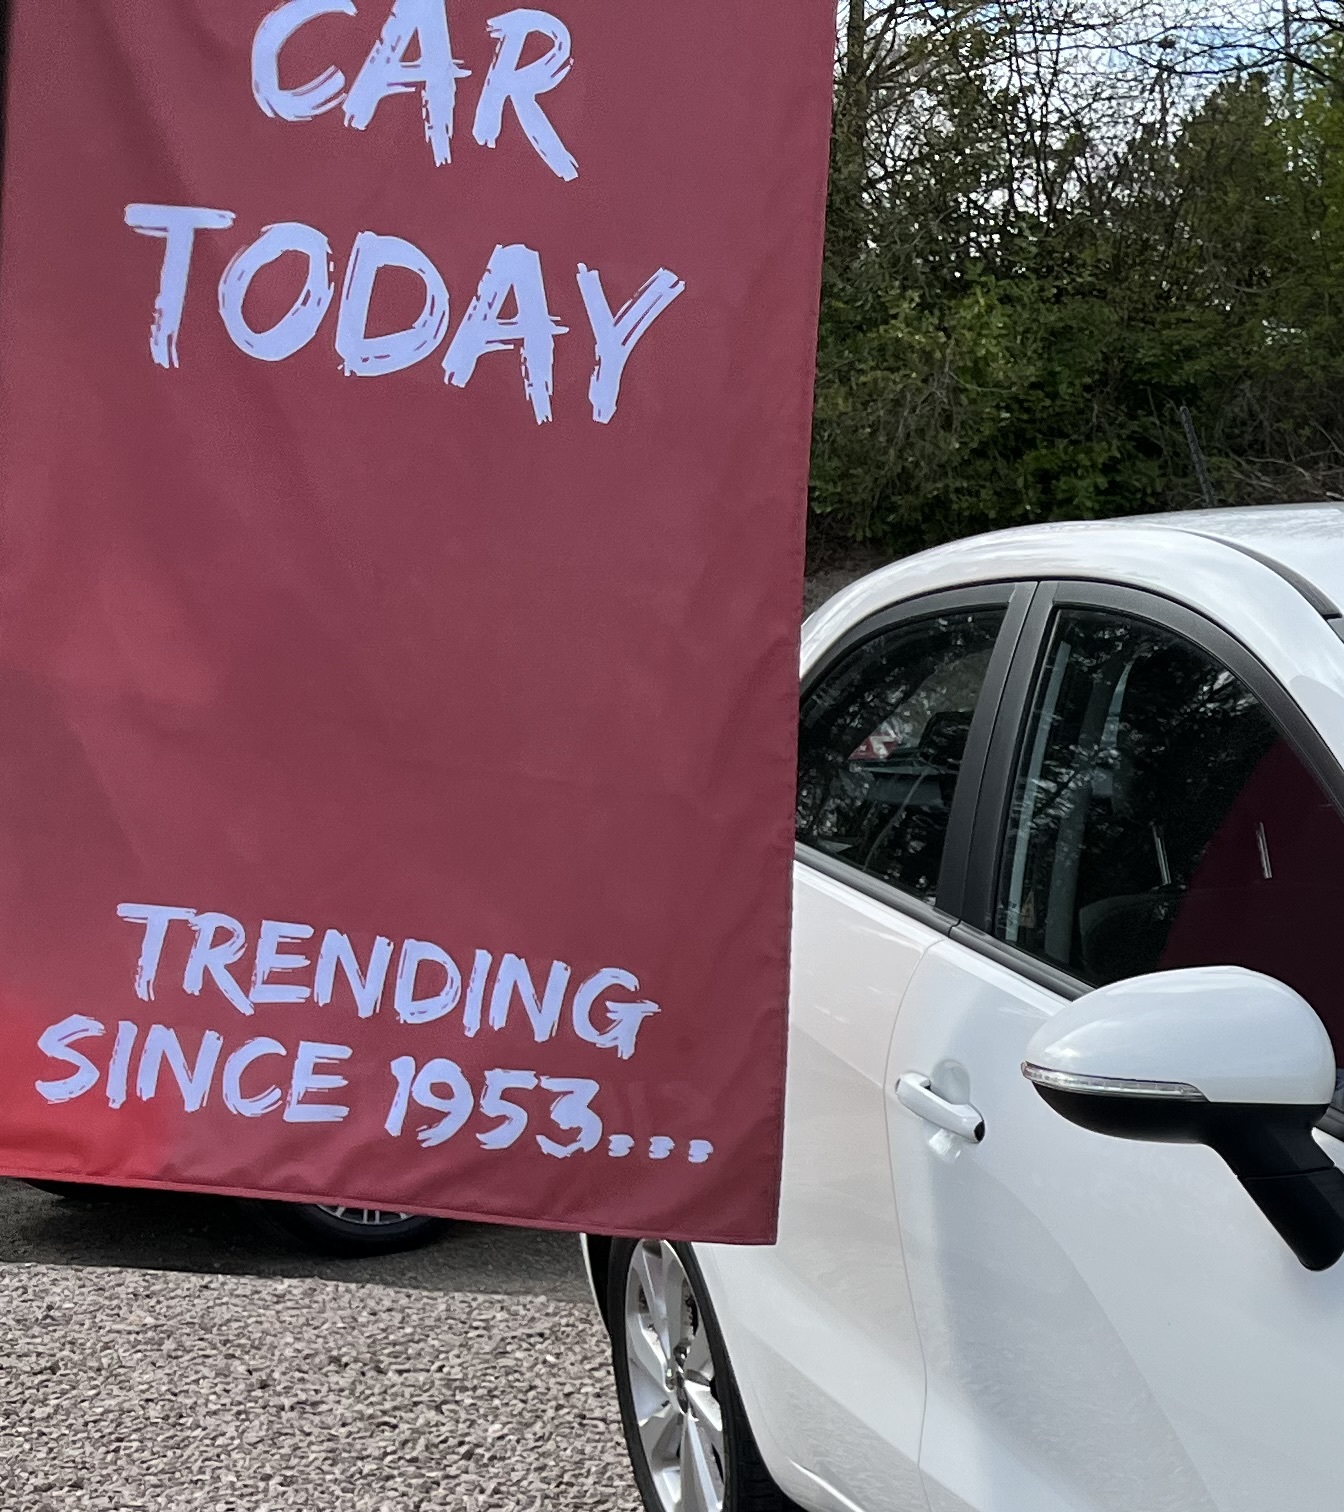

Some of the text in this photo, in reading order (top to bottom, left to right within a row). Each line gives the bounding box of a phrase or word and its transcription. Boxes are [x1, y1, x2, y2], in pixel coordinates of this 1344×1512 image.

[252, 0, 578, 181] CAR
[124, 203, 685, 425] TODAY
[117, 903, 661, 1060] TRENDING
[35, 1014, 715, 1164] SINCE 1953...
